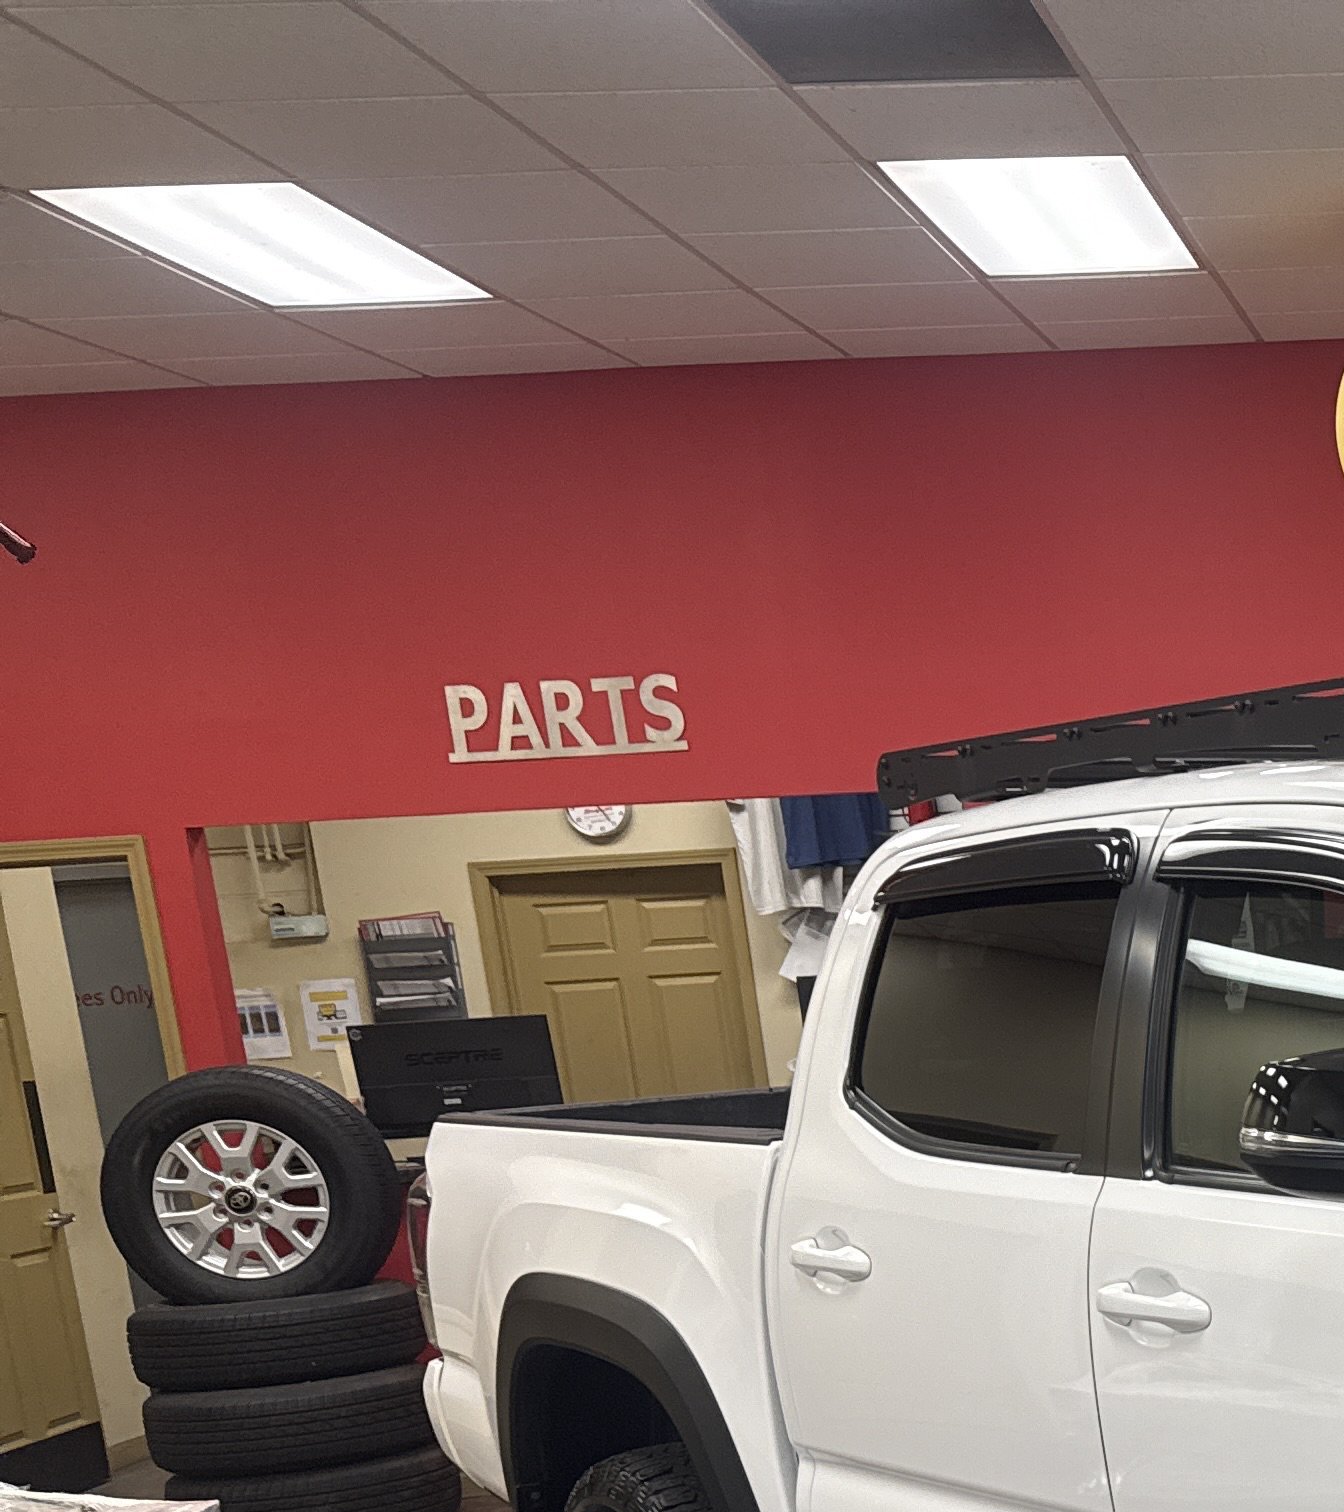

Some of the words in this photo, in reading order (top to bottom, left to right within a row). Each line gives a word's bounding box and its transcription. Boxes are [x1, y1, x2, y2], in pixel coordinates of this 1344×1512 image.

[444, 673, 688, 761] PARTS
[110, 984, 153, 1008] Only
[404, 1048, 504, 1067] SCEPTRE
